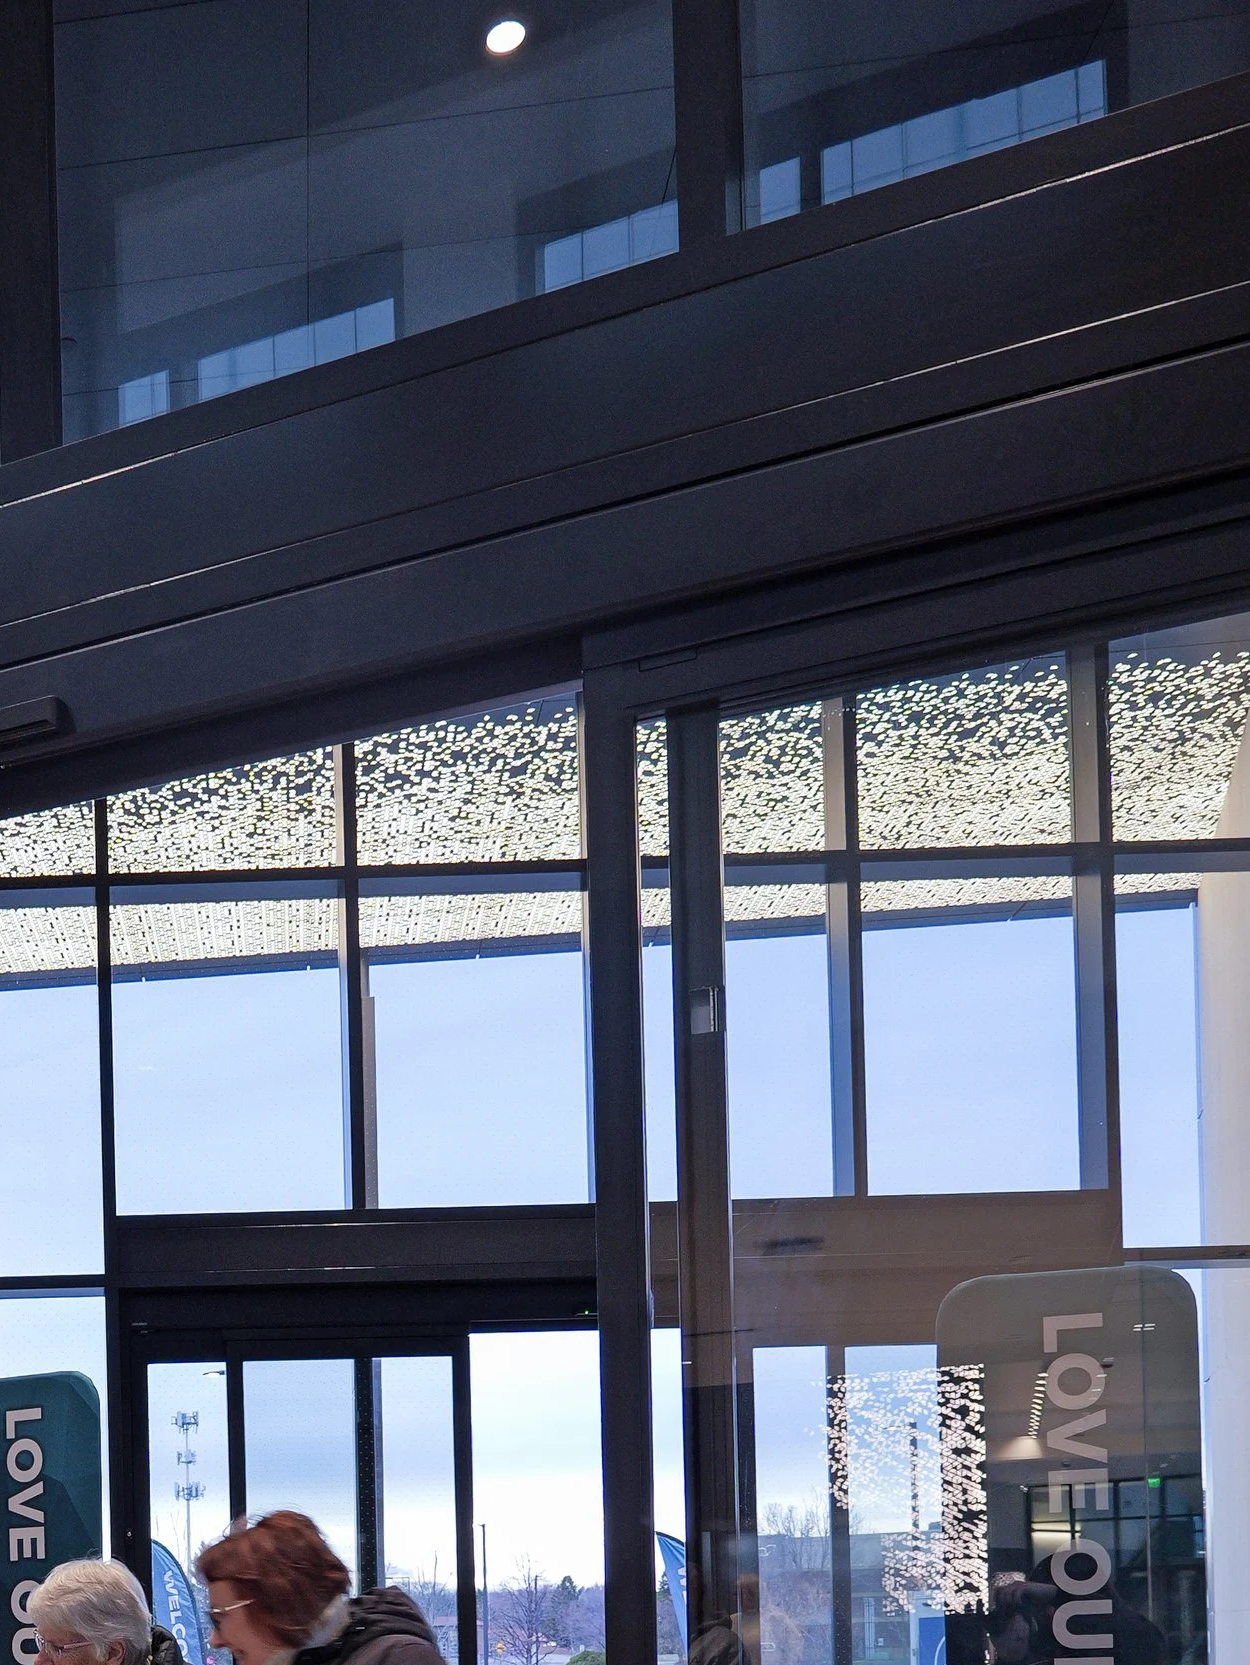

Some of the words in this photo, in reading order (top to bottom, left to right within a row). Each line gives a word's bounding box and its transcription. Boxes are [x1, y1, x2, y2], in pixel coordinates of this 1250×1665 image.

[5, 1407, 46, 1562] LOVE
[1042, 1312, 1110, 1514] LOVE
[163, 1569, 189, 1661] WELCO
